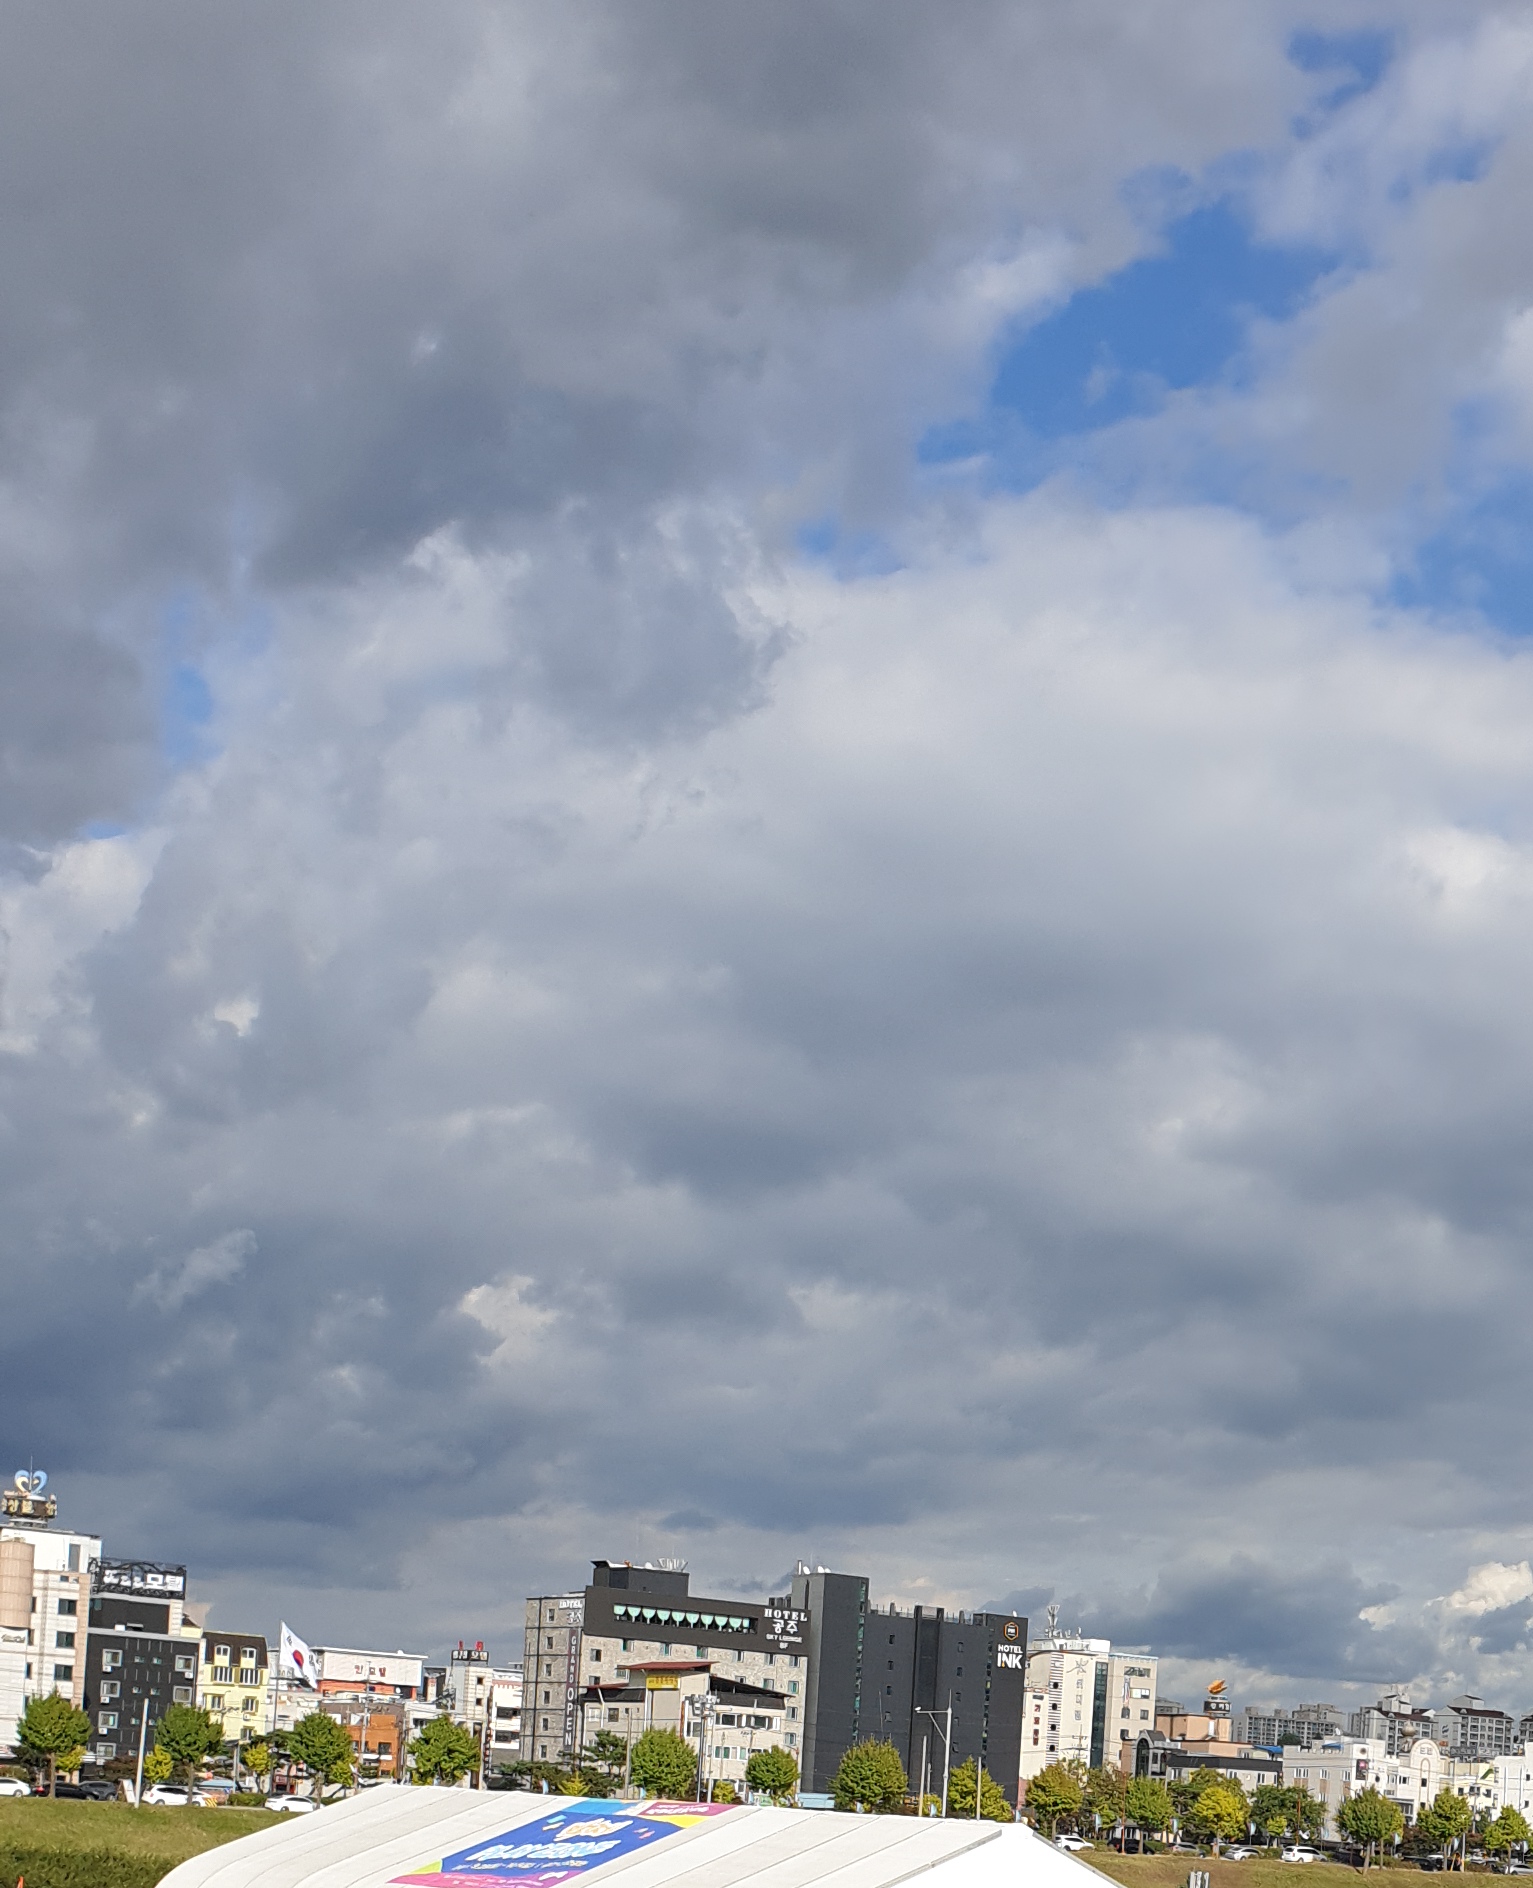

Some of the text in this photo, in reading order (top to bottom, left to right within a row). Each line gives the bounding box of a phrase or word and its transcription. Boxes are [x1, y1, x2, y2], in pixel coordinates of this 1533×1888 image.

[763, 1608, 808, 1622] HOTEL
[772, 1618, 799, 1635] 공주
[997, 1643, 1024, 1654] HOTEL
[996, 1655, 1023, 1670] INK
[564, 1634, 578, 1746] GRAND OPEN
